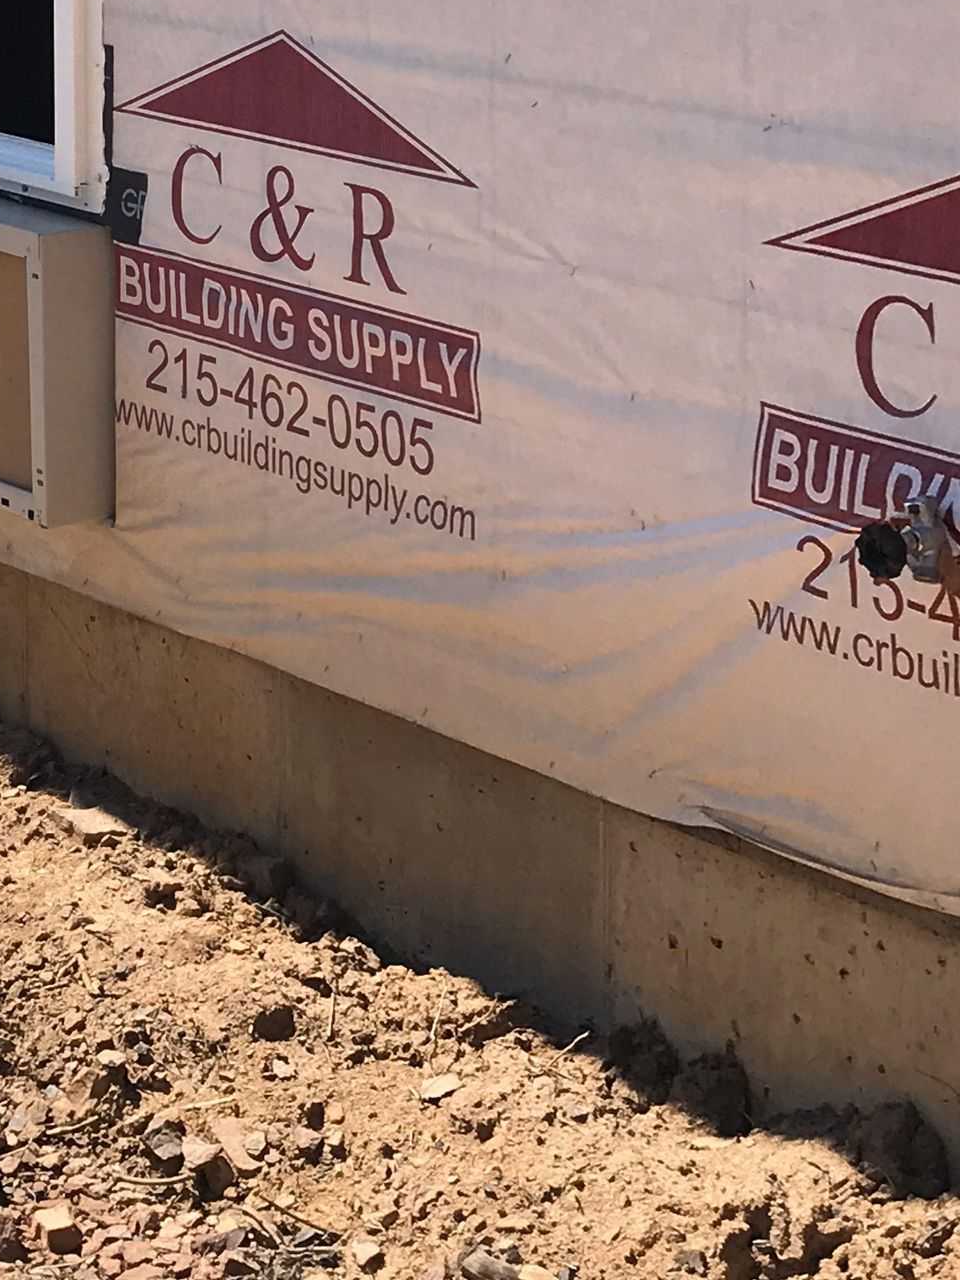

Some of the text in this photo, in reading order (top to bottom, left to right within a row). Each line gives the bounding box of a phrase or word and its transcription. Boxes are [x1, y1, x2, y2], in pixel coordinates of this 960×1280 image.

[171, 146, 407, 295] C & R
[119, 255, 467, 398] BUILDING SUPPLY
[855, 295, 937, 418] C
[115, 397, 476, 540] www.crbuildingsupply.com
[146, 339, 435, 476] 215-462-0505
